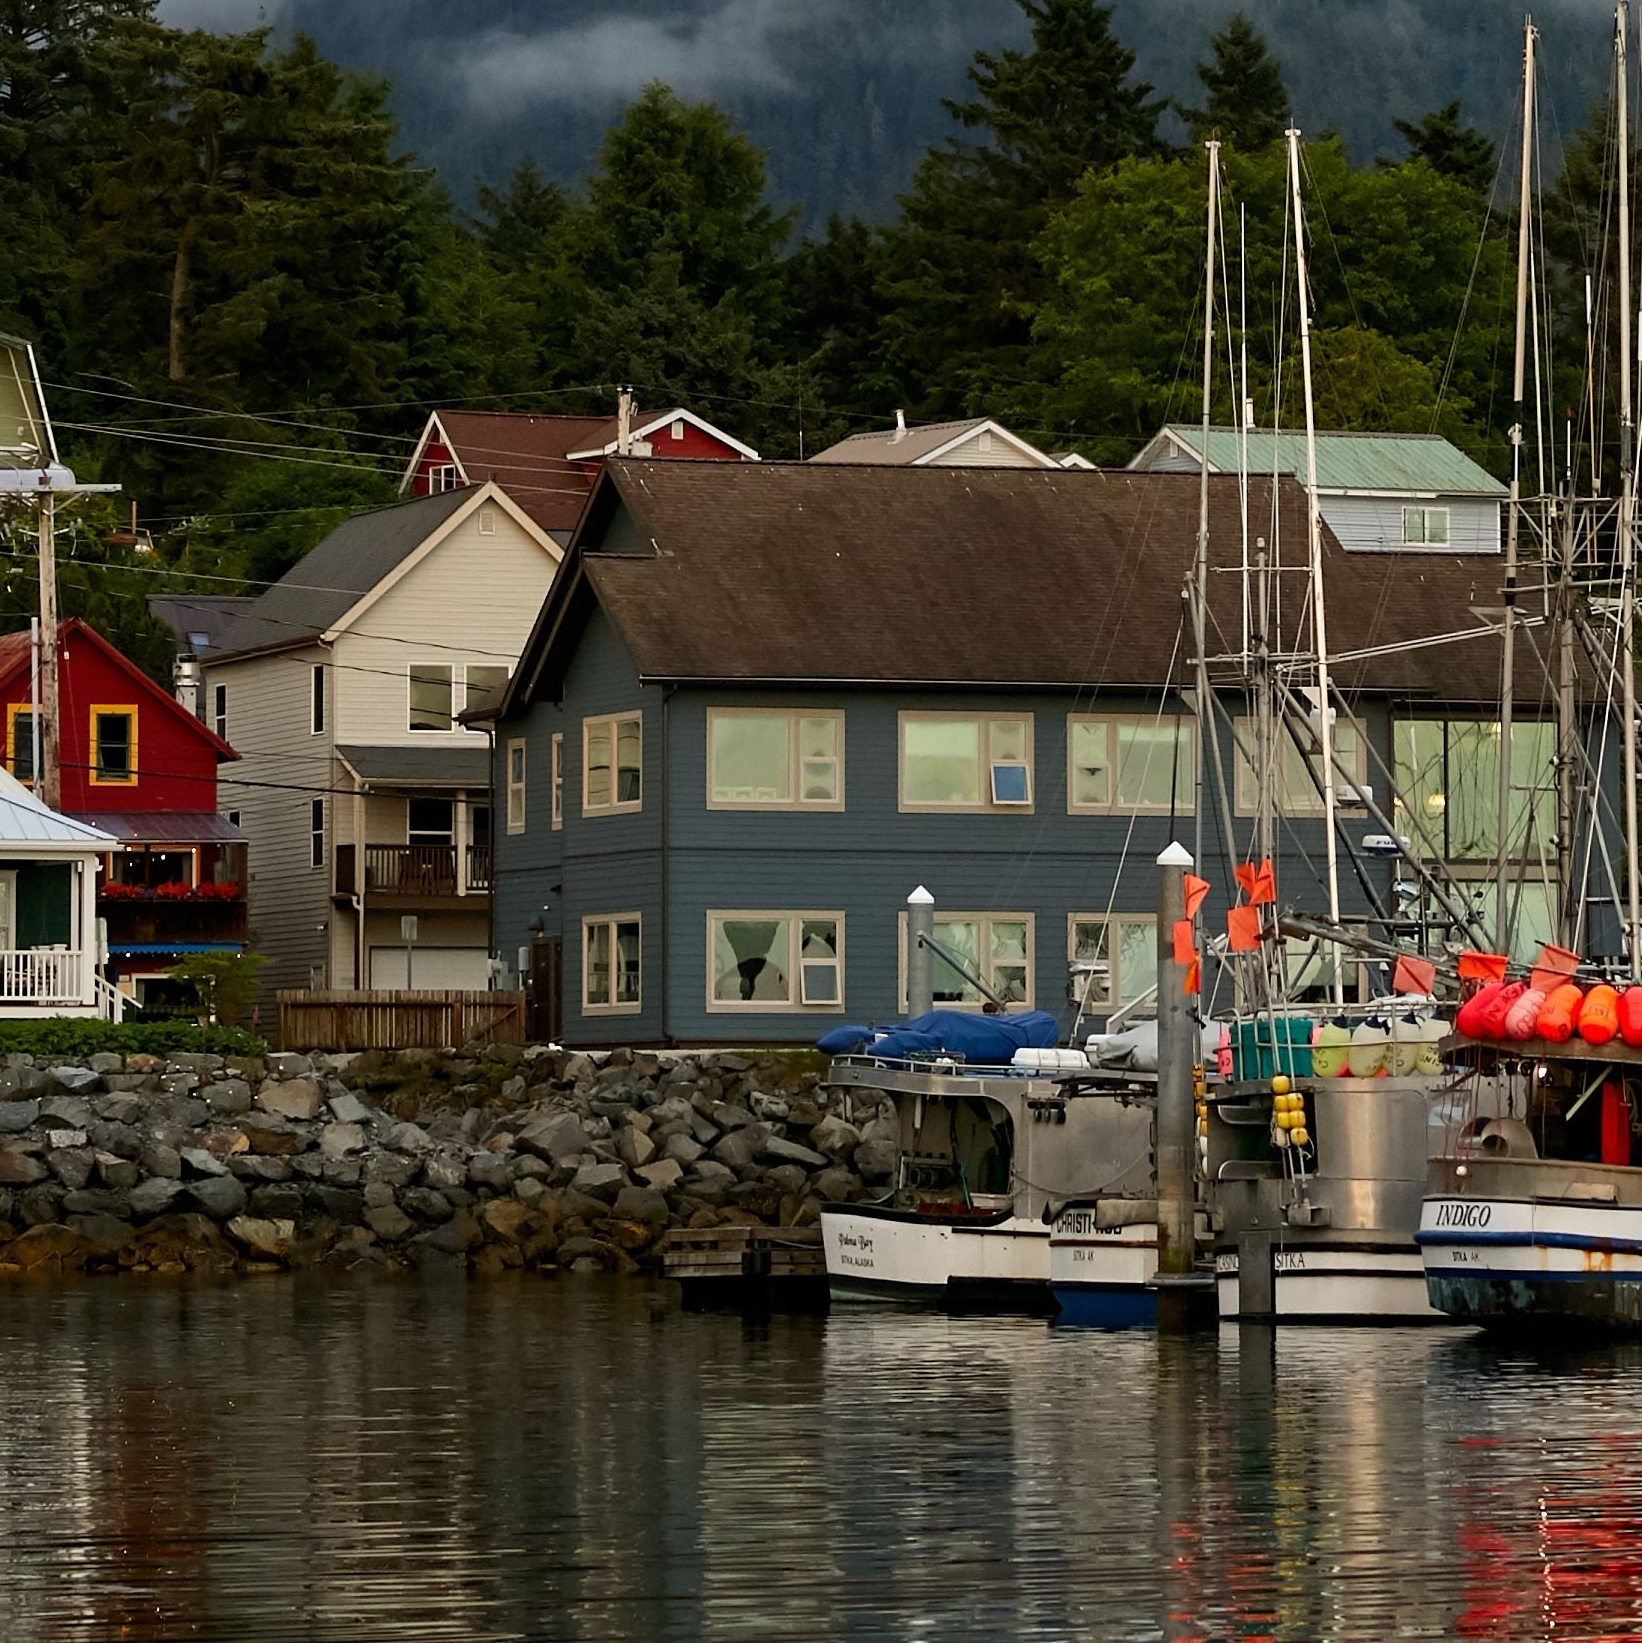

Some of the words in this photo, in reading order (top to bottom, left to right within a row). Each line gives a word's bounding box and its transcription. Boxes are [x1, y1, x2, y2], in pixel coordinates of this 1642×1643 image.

[1056, 1213, 1092, 1234] CHRISTI
[1436, 1204, 1491, 1227] INDIGO
[1275, 1253, 1306, 1269] SITKA
